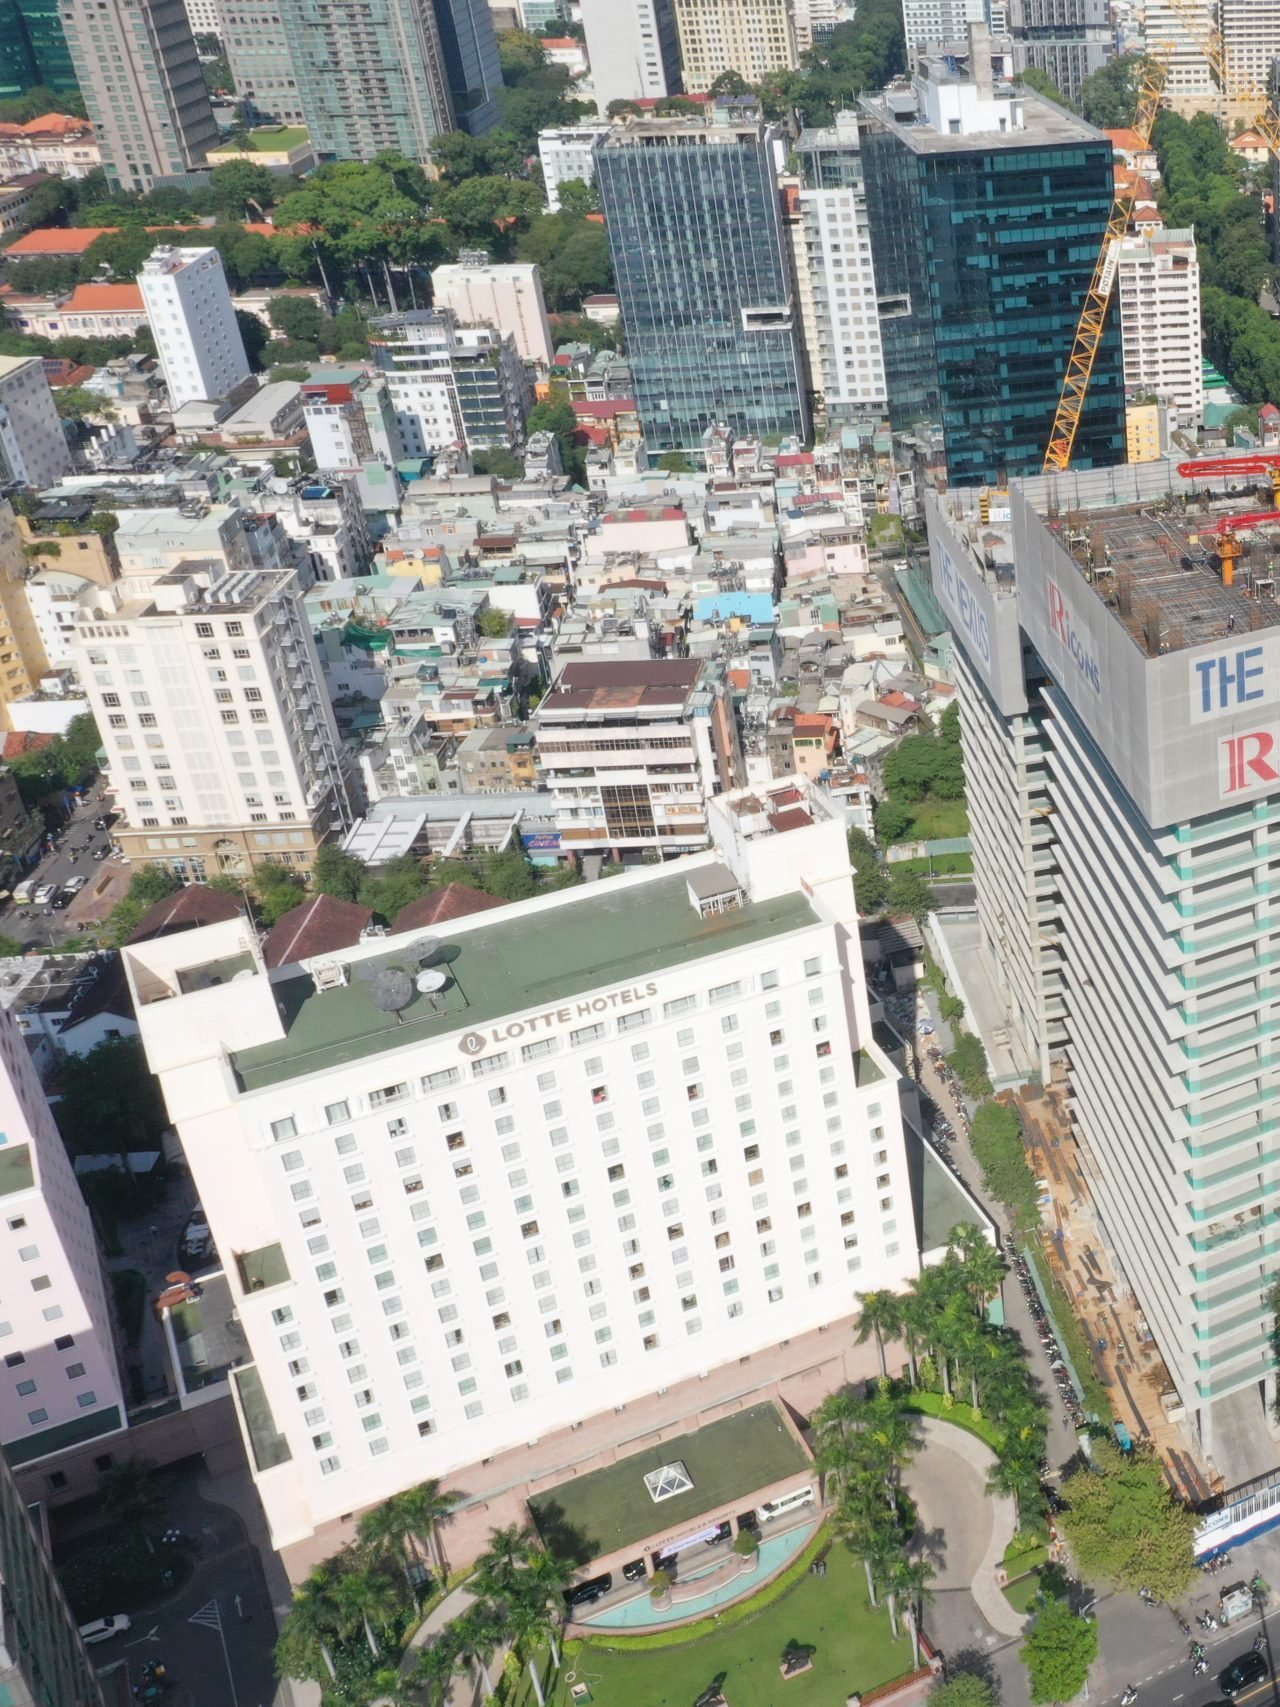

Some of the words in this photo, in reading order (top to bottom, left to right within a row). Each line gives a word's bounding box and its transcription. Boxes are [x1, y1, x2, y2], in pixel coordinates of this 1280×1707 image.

[1101, 259, 1115, 293] POTAIN
[1195, 646, 1264, 713] THE
[491, 1007, 571, 1043] LOTTE
[576, 982, 658, 1018] HOTELS
